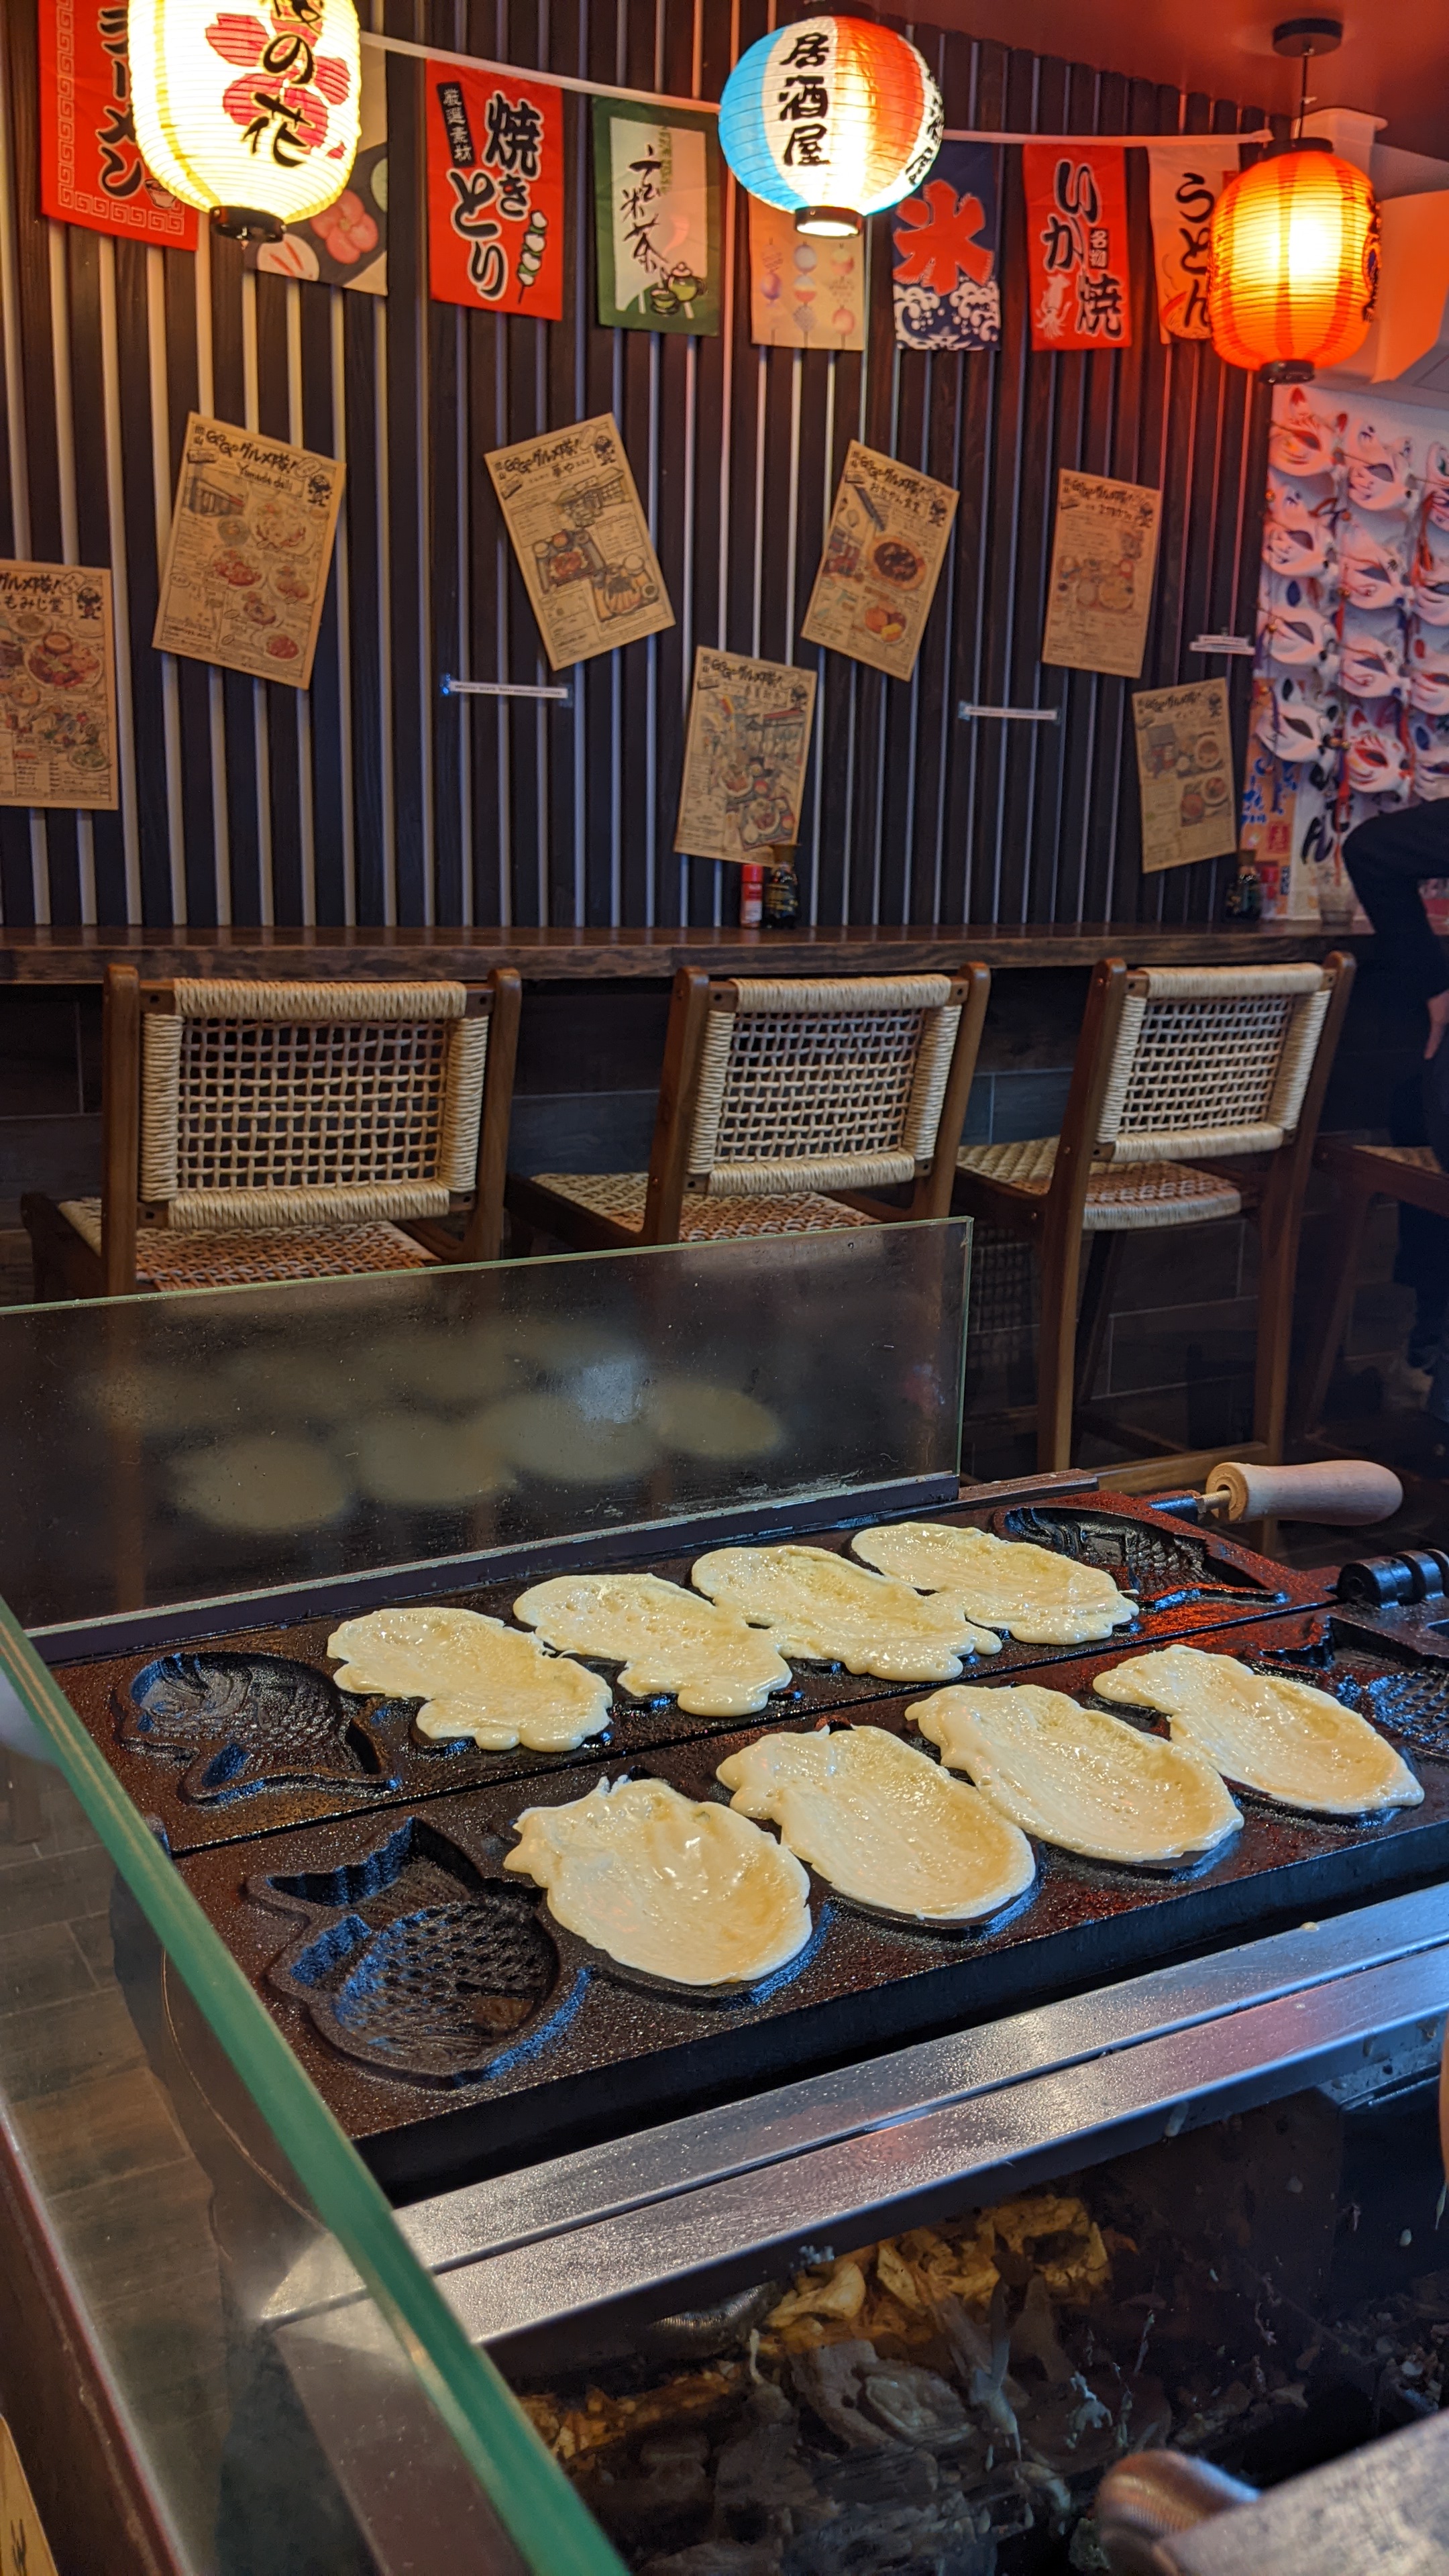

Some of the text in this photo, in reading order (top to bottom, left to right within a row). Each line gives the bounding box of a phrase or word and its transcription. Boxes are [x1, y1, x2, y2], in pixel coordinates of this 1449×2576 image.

[779, 32, 832, 166] 居酒屋
[447, 92, 541, 300] 焼きとり
[892, 178, 994, 297] 氷
[1041, 160, 1123, 339] いか焼
